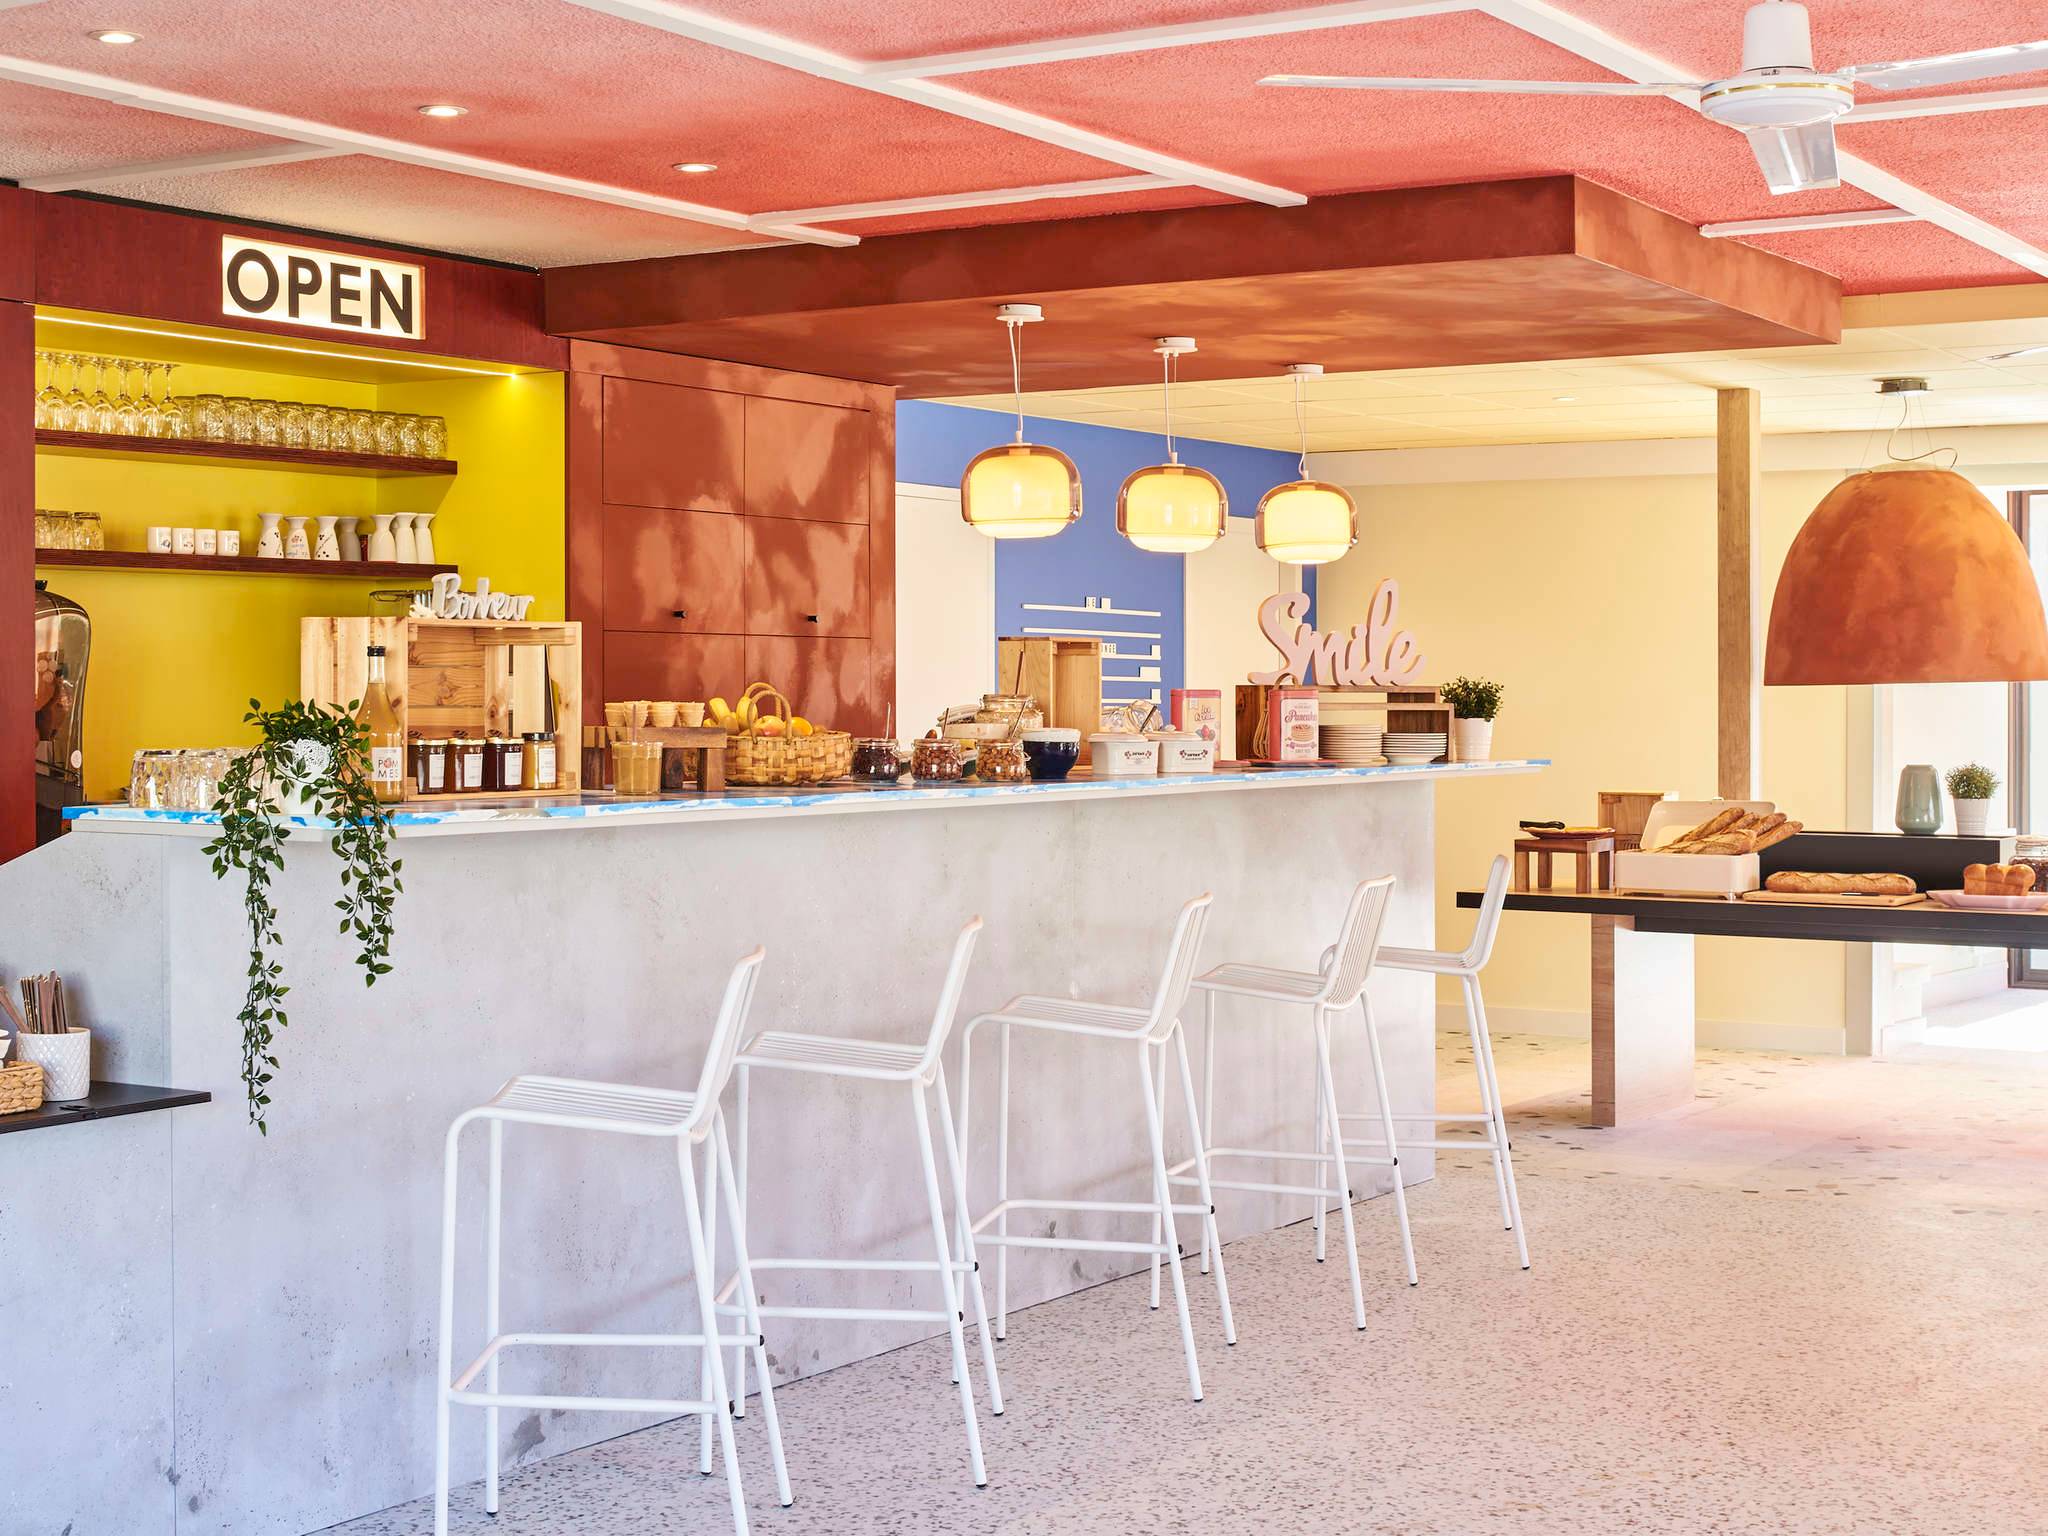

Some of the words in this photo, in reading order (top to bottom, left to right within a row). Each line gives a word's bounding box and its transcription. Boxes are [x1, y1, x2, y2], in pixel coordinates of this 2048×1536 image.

[227, 248, 412, 334] OPEN
[431, 572, 535, 621] Bonheur
[1247, 577, 1427, 687] Smile
